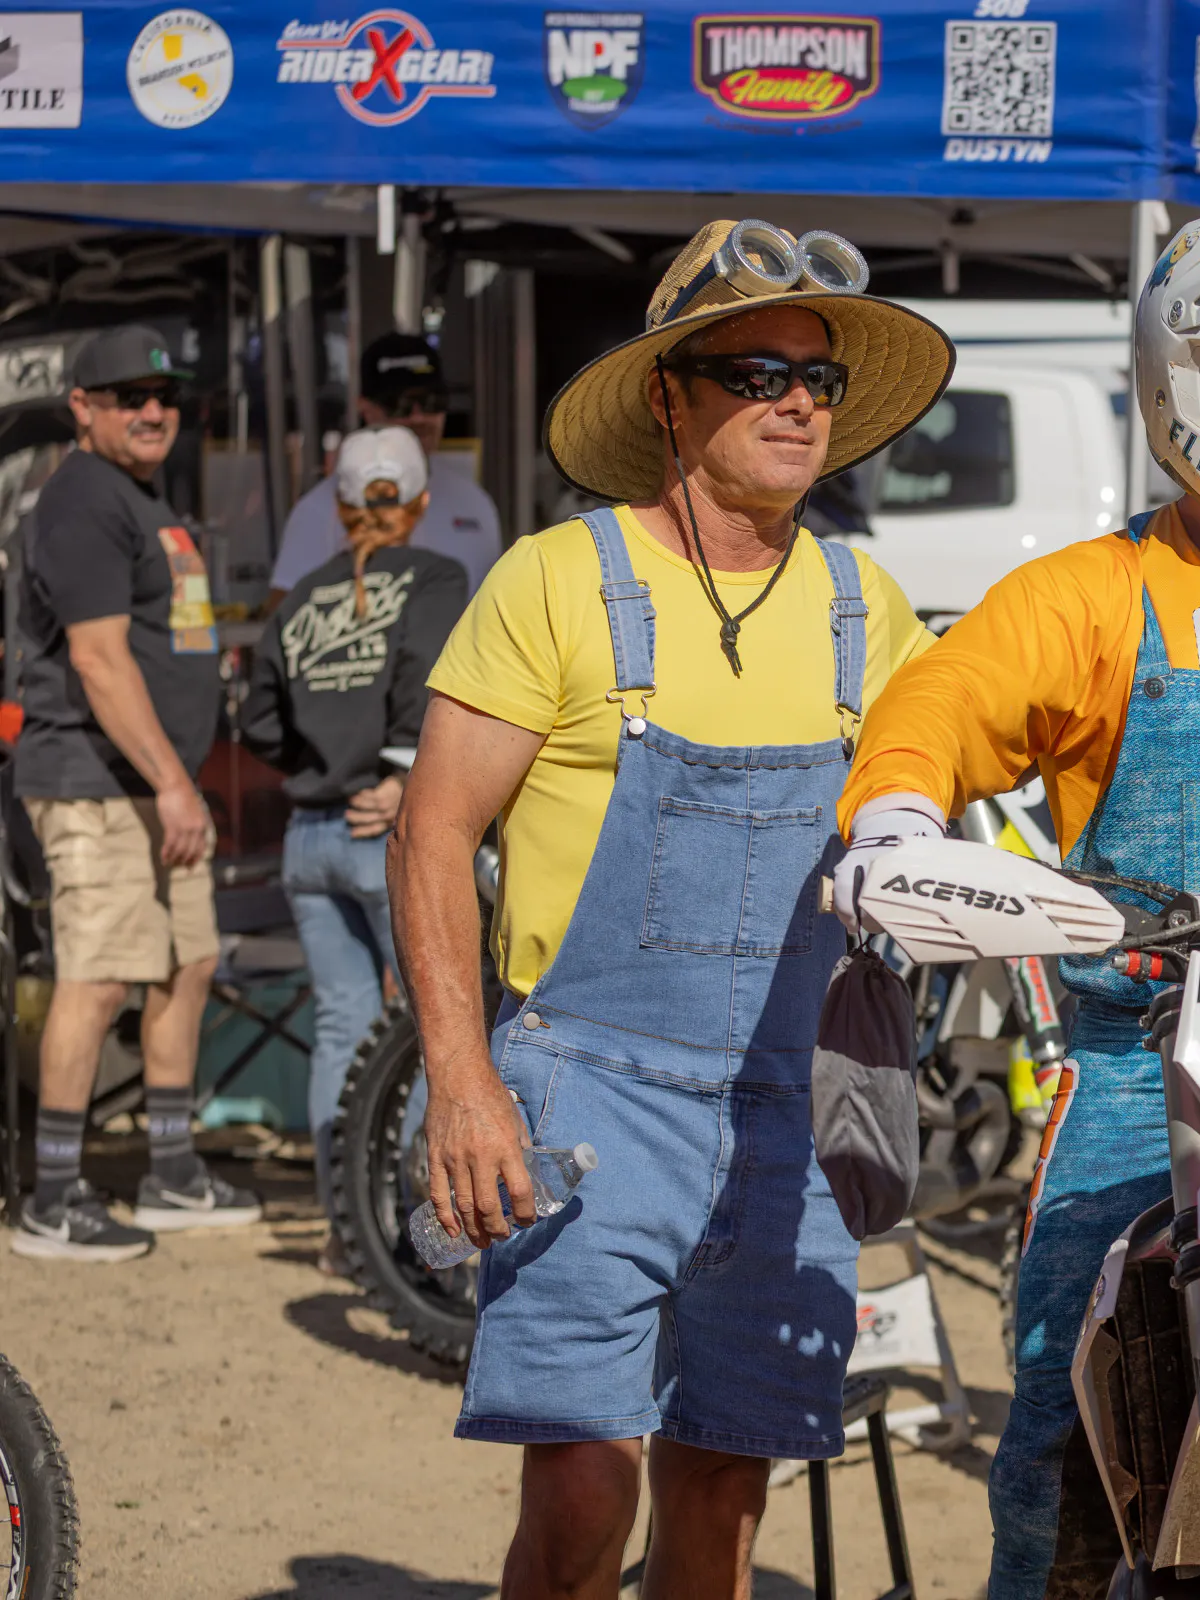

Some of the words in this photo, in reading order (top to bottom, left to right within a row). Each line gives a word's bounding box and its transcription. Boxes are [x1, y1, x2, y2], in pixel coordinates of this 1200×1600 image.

[547, 29, 640, 86] NPF
[706, 25, 868, 80] THOMPSON
[726, 68, 847, 112] Family
[944, 138, 1053, 163] DUSTYN
[881, 874, 1026, 916] ACERBIS
